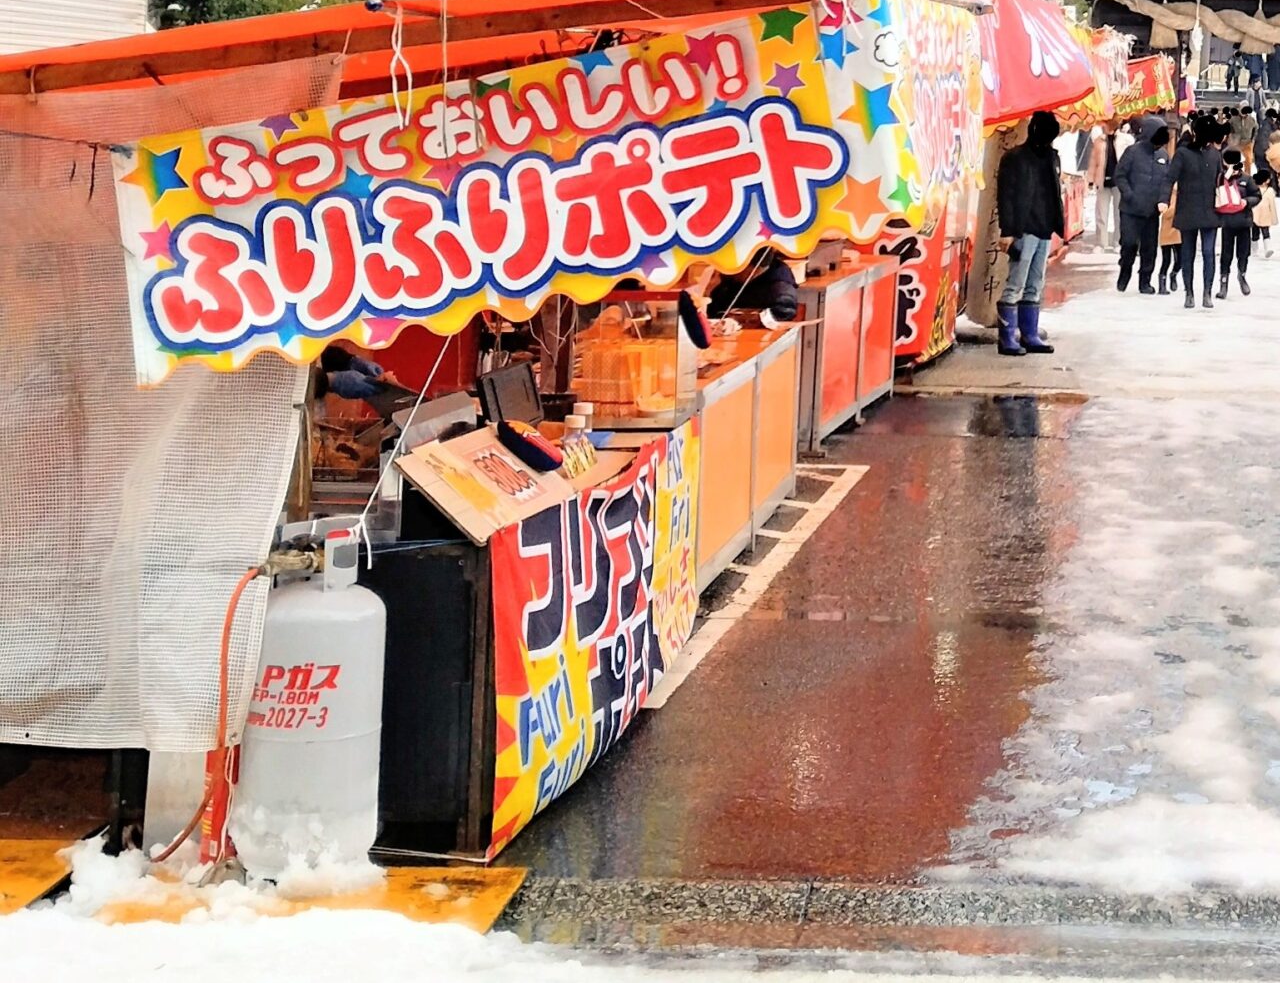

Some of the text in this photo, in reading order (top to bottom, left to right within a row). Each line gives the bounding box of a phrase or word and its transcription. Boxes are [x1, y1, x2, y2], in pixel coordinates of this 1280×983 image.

[194, 34, 749, 205] ふっておいしい!
[146, 100, 847, 347] ふりふりポテト
[254, 662, 341, 691] Pガス
[265, 706, 329, 729] 2027-3
[519, 653, 577, 767] Furi
